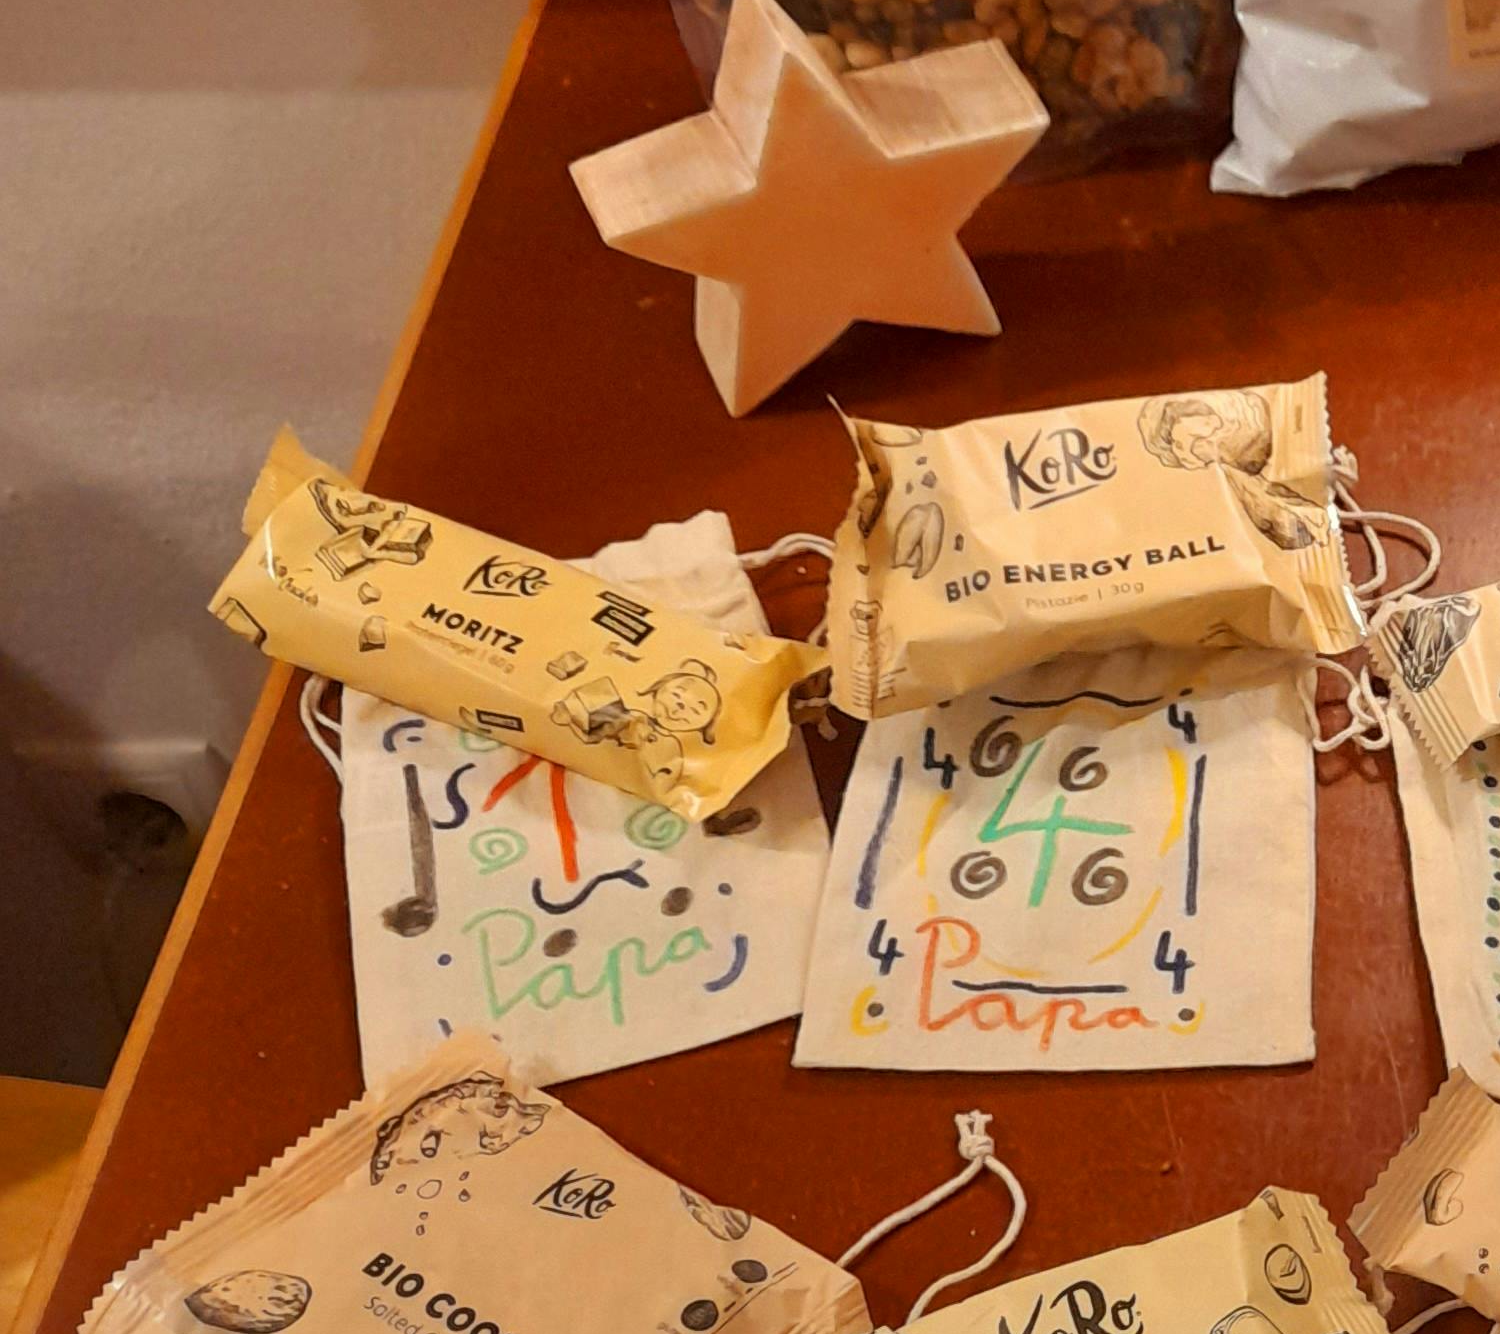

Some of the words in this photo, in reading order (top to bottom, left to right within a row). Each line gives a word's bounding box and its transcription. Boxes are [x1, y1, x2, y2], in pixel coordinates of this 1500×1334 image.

[1004, 427, 1117, 510] KoRo
[463, 555, 552, 597] KoRo
[945, 570, 990, 602] BIO
[1003, 553, 1132, 584] ENERGY
[1145, 536, 1225, 565] BALL
[421, 603, 524, 655] MORITZ
[978, 739, 1134, 908] 4
[462, 907, 712, 1026] Papa
[916, 917, 1160, 1052] Papa
[532, 1167, 616, 1220] KoRo
[362, 1252, 424, 1299] BIO
